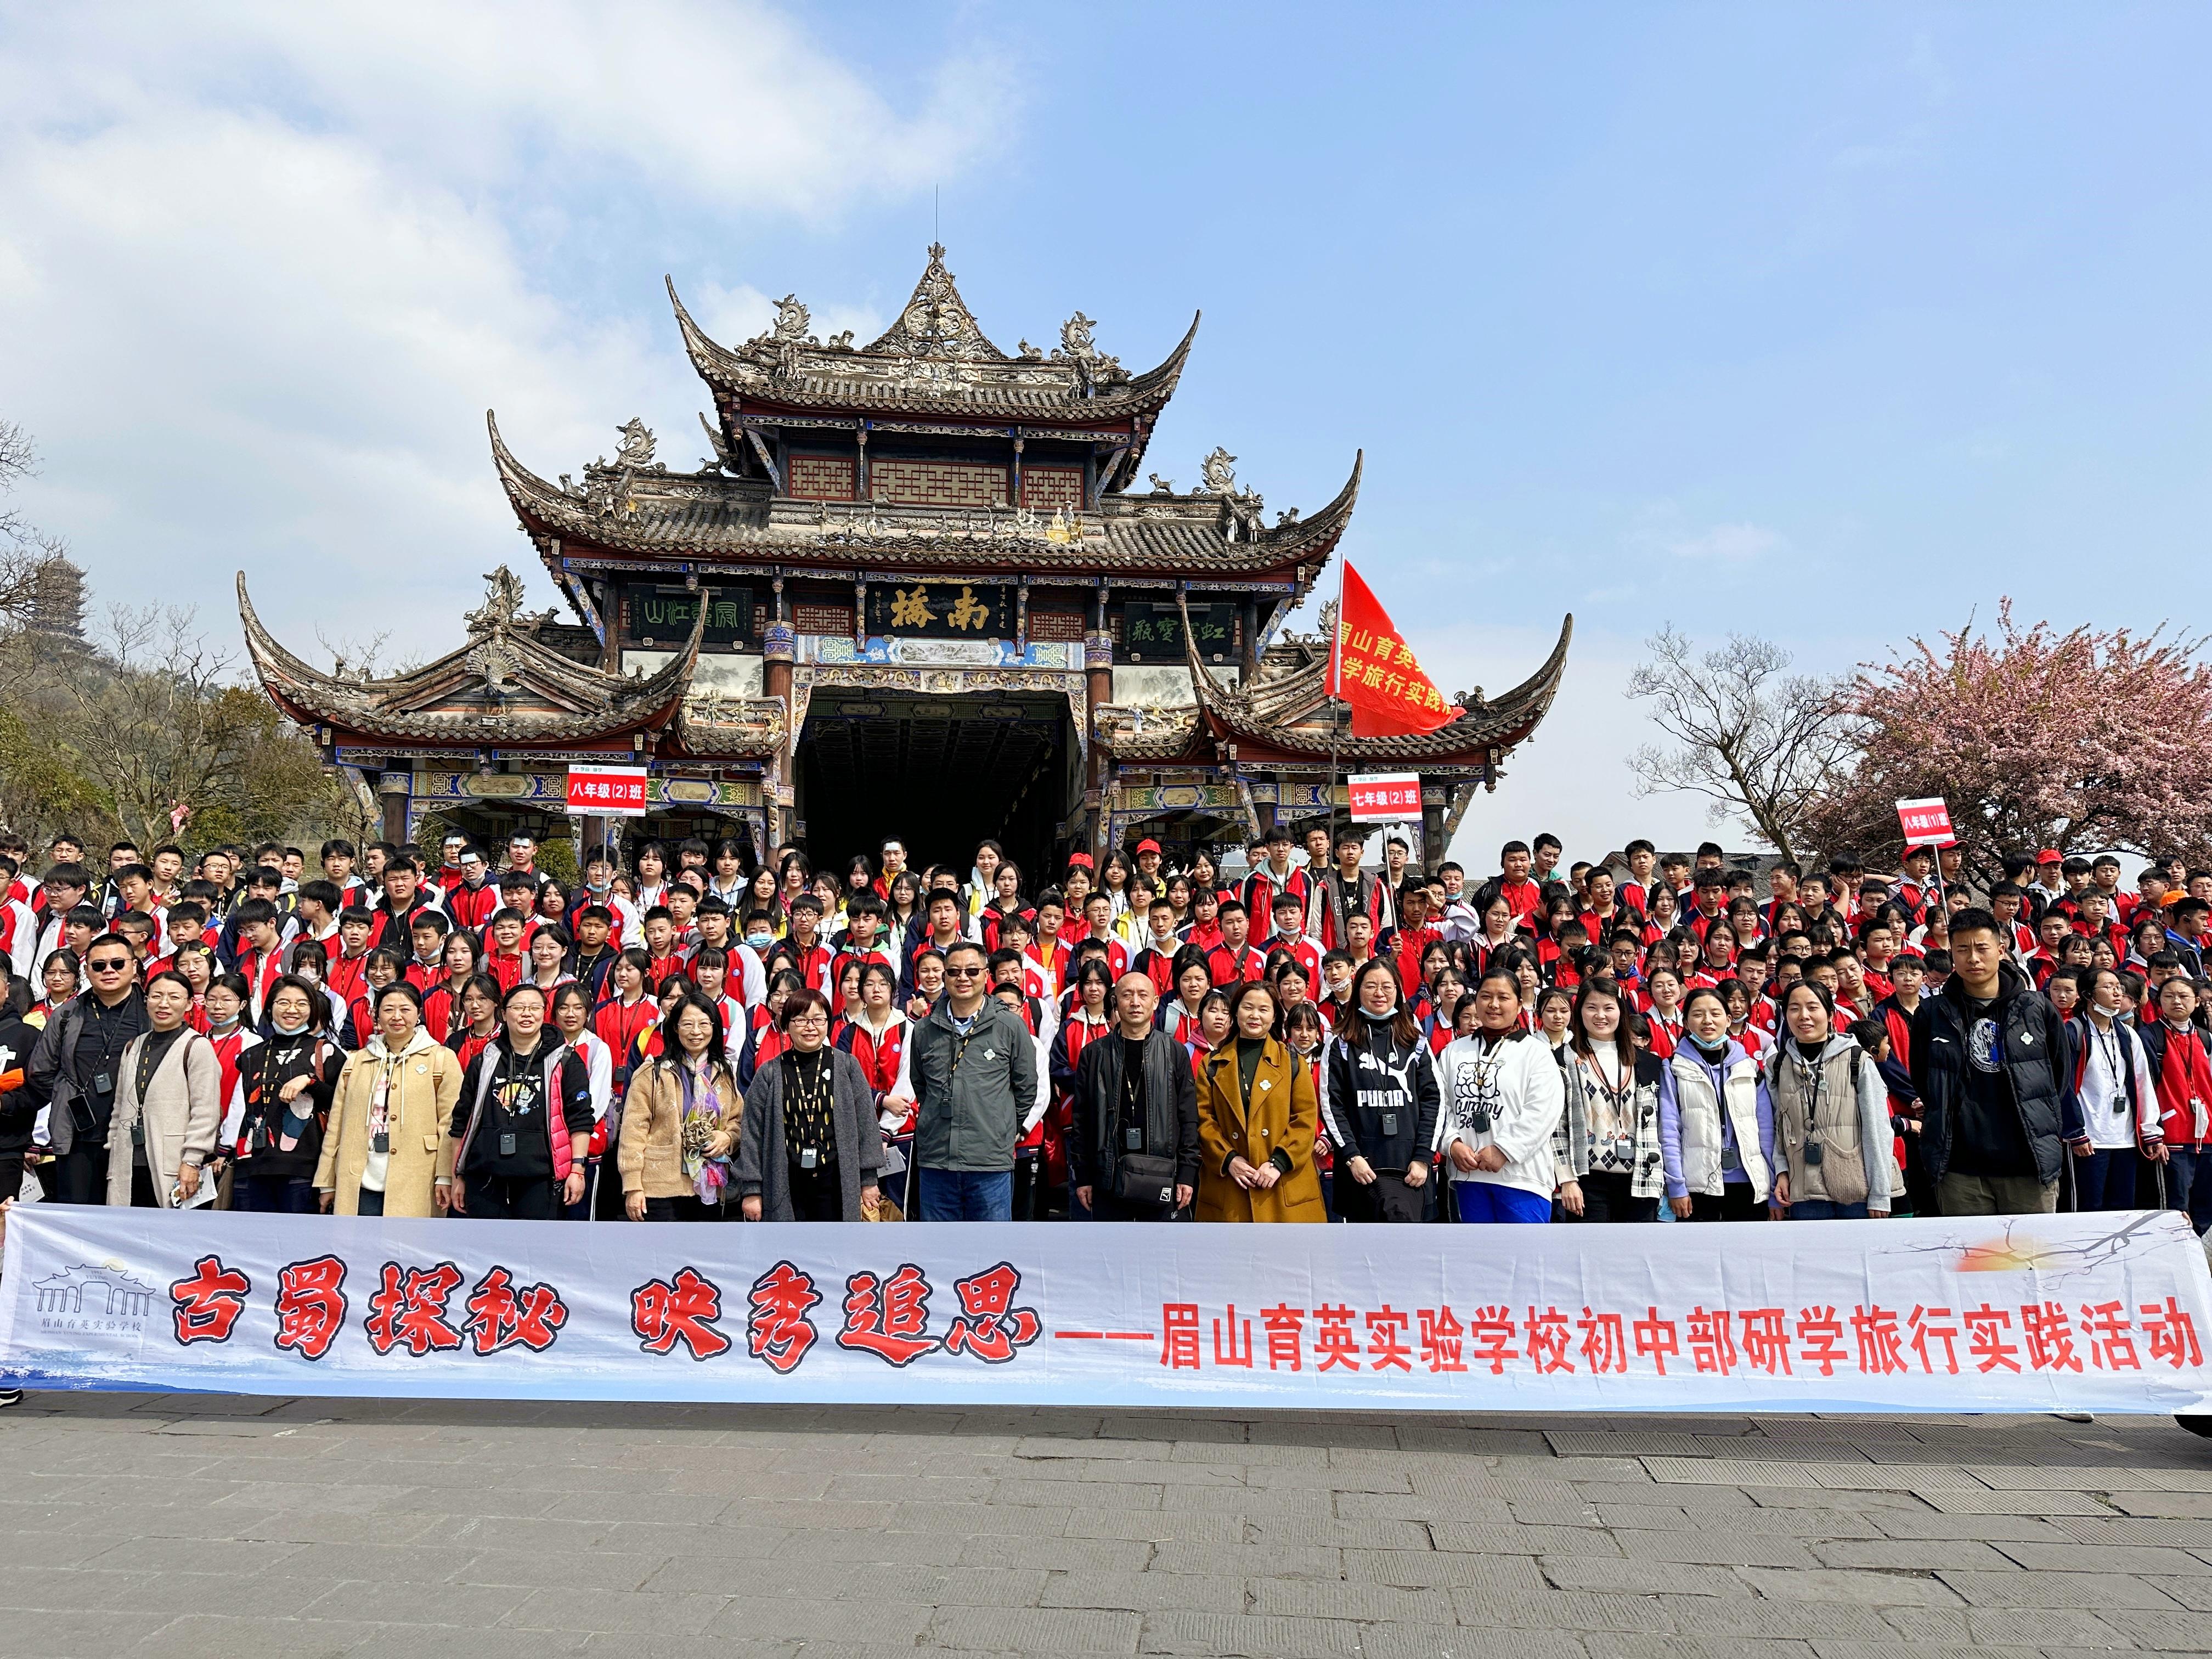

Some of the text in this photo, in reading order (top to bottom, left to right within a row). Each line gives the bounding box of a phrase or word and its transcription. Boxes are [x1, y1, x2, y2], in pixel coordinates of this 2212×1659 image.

[571, 782, 642, 800] 八年级(2)班
[1352, 789, 1418, 807] 七年级(2)班
[1904, 812, 1949, 830] 八年级(1)班
[1357, 1090, 1404, 1107] PUMA
[1455, 1098, 1504, 1120] Gummy
[170, 1254, 570, 1361] 古蜀探秘
[631, 1260, 1042, 1375] 映秀追思
[41, 1318, 142, 1332] 眉山育英实验学校
